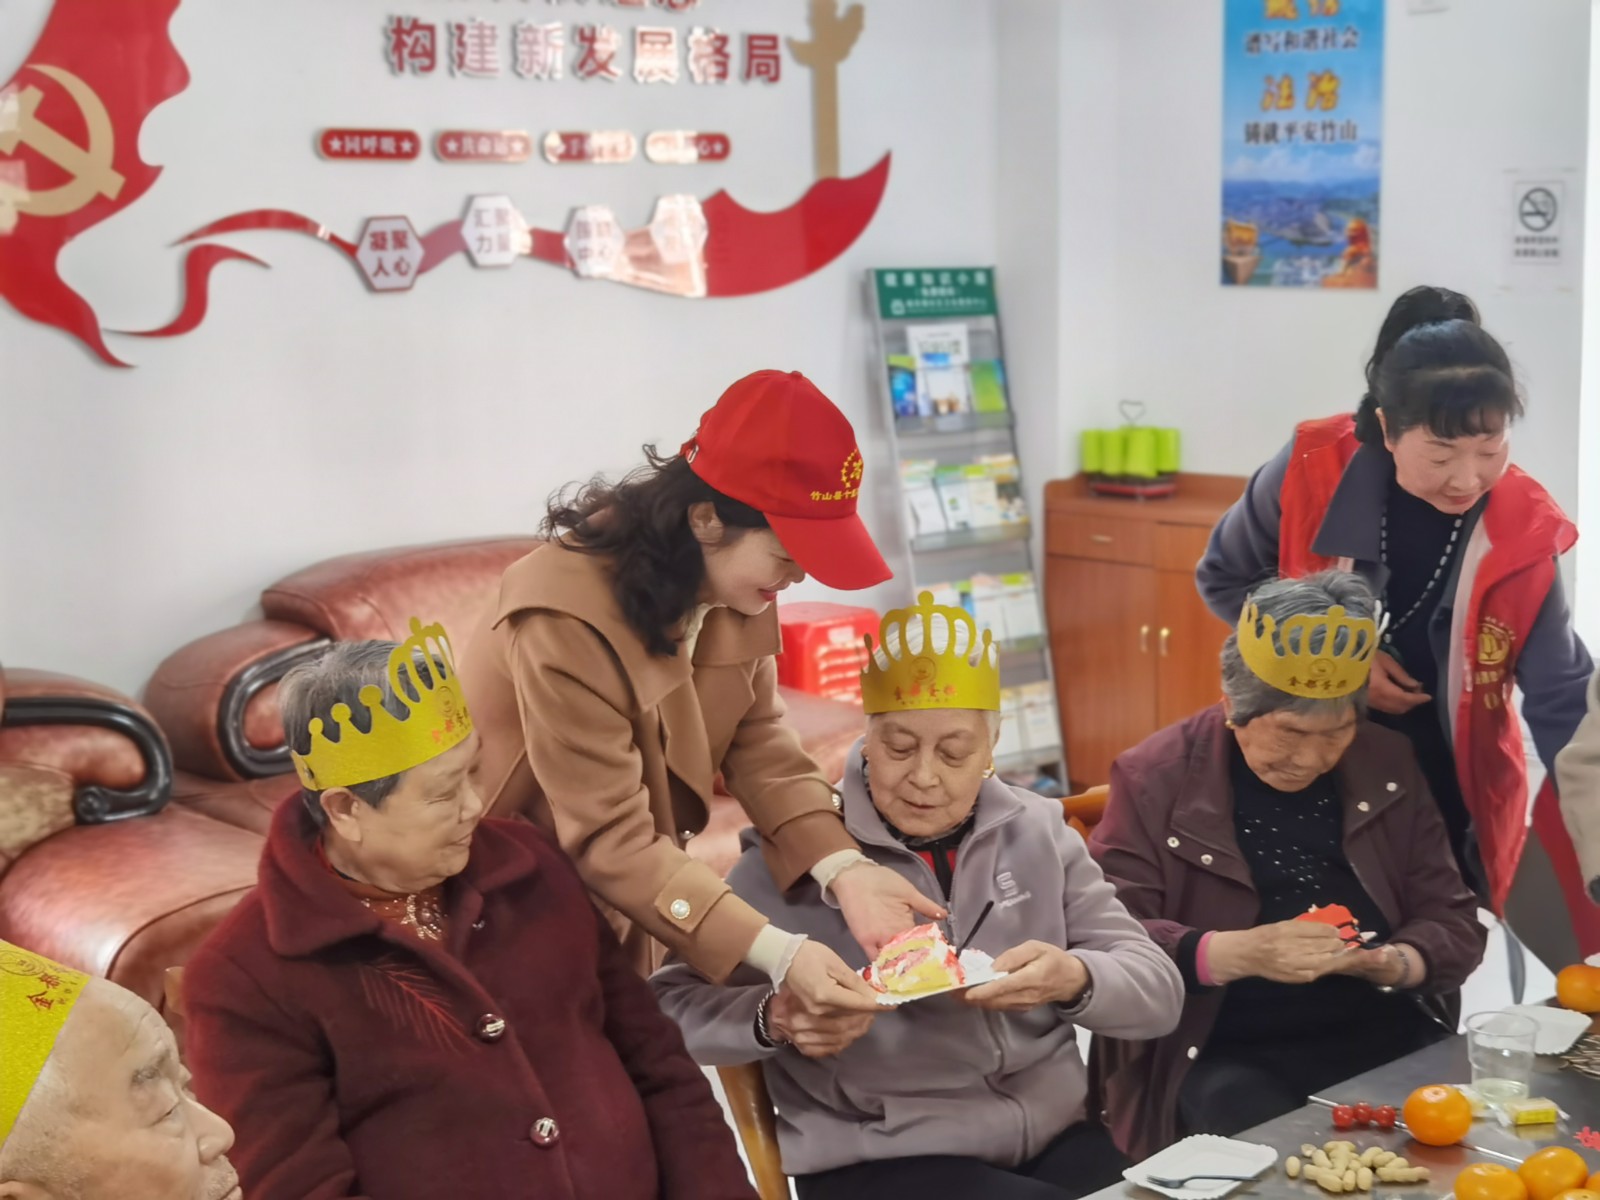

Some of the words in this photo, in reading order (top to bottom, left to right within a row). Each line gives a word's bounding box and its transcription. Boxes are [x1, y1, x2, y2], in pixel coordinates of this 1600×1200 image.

[388, 16, 783, 83] 构建新发展格局
[344, 135, 396, 154] 同呼吸
[369, 230, 409, 251] 凝聚
[372, 257, 411, 277] 人心
